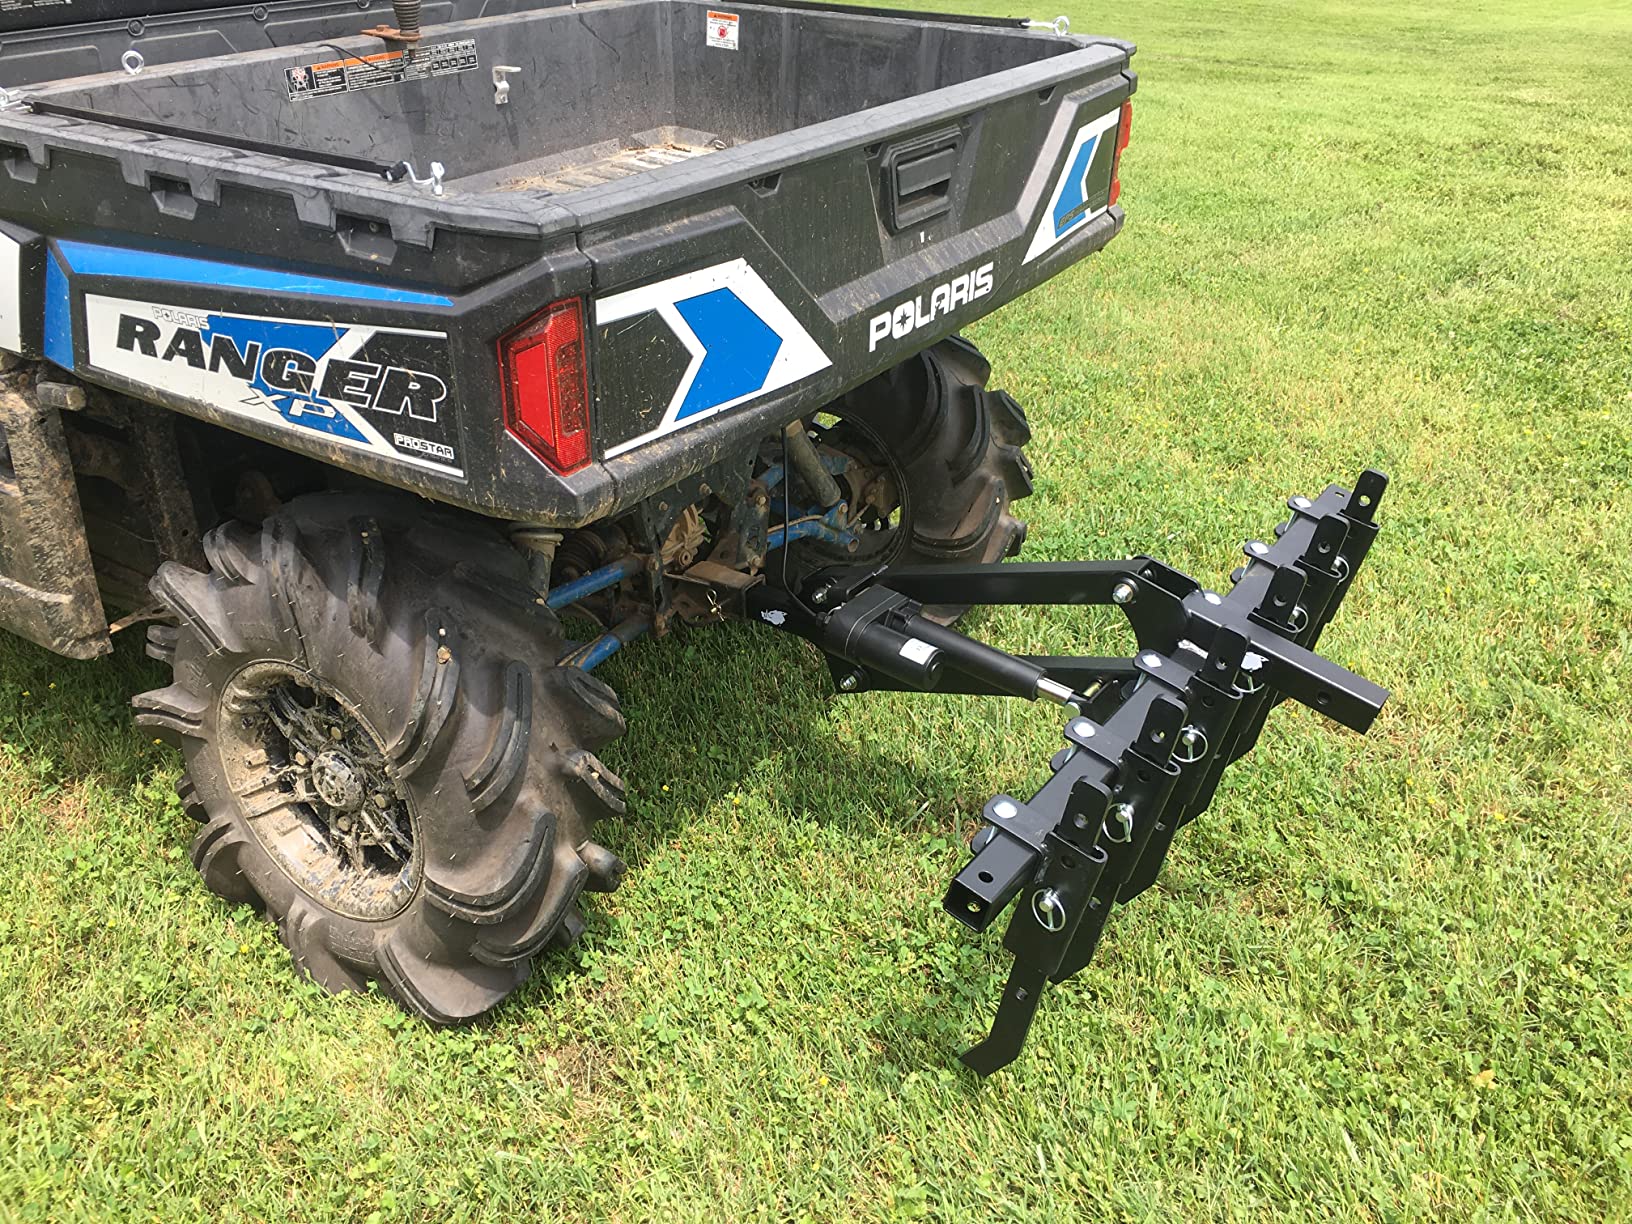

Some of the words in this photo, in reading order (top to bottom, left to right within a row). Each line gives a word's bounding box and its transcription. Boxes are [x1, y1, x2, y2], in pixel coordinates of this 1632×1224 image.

[151, 305, 210, 330] POLARIS
[869, 262, 994, 353] POLARIS
[116, 313, 447, 423] RANGER
[240, 387, 337, 418] XP
[394, 435, 453, 458] PROSTAR
